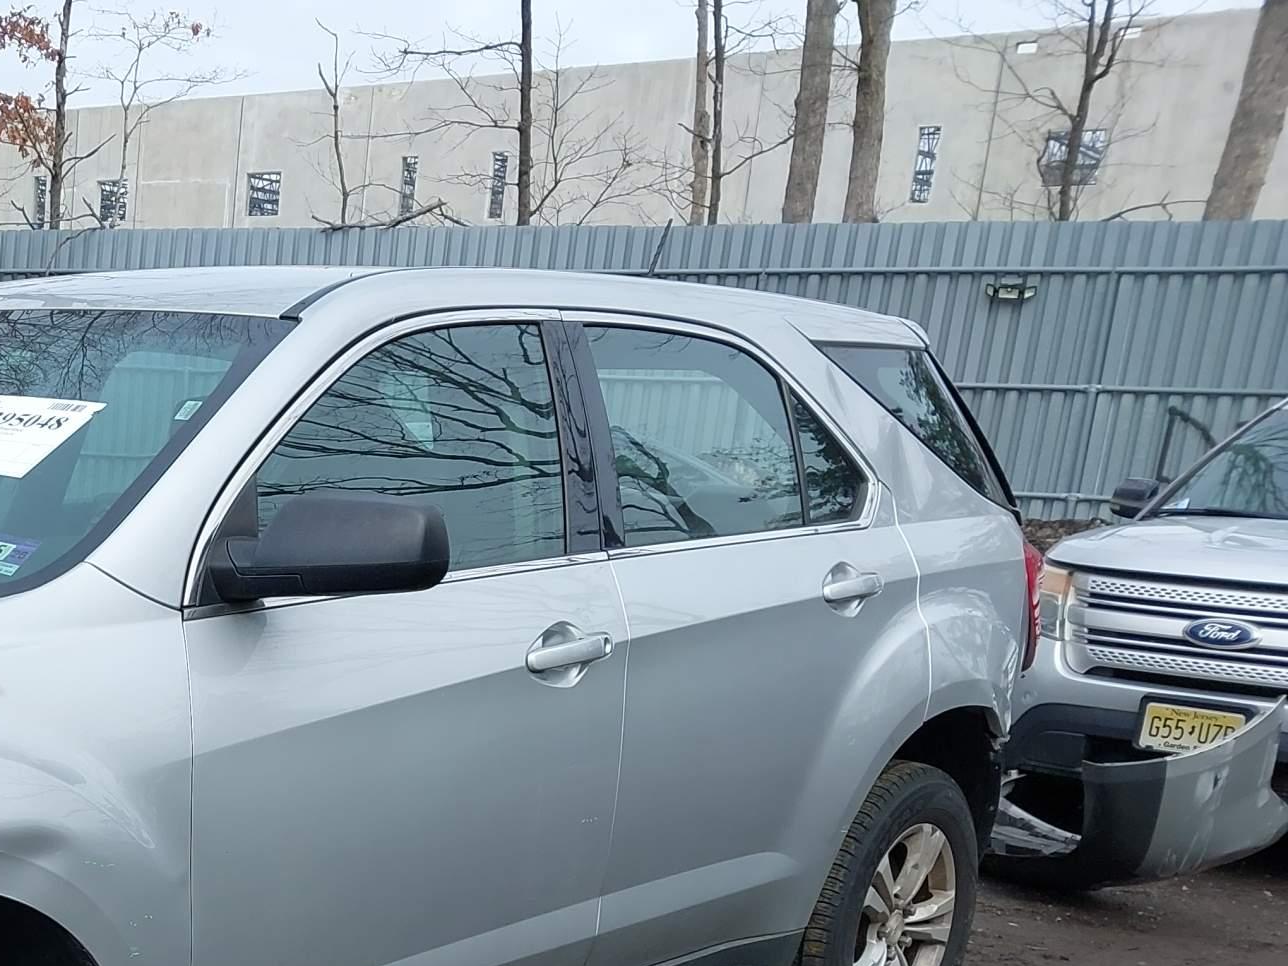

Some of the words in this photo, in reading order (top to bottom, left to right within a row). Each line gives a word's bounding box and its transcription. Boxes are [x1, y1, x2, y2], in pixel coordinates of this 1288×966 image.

[1198, 623, 1242, 641] Ford
[1171, 708, 1190, 718] New
[1193, 711, 1219, 722] Jersey
[1148, 715, 1187, 741] G55
[1163, 741, 1191, 751] Garden
